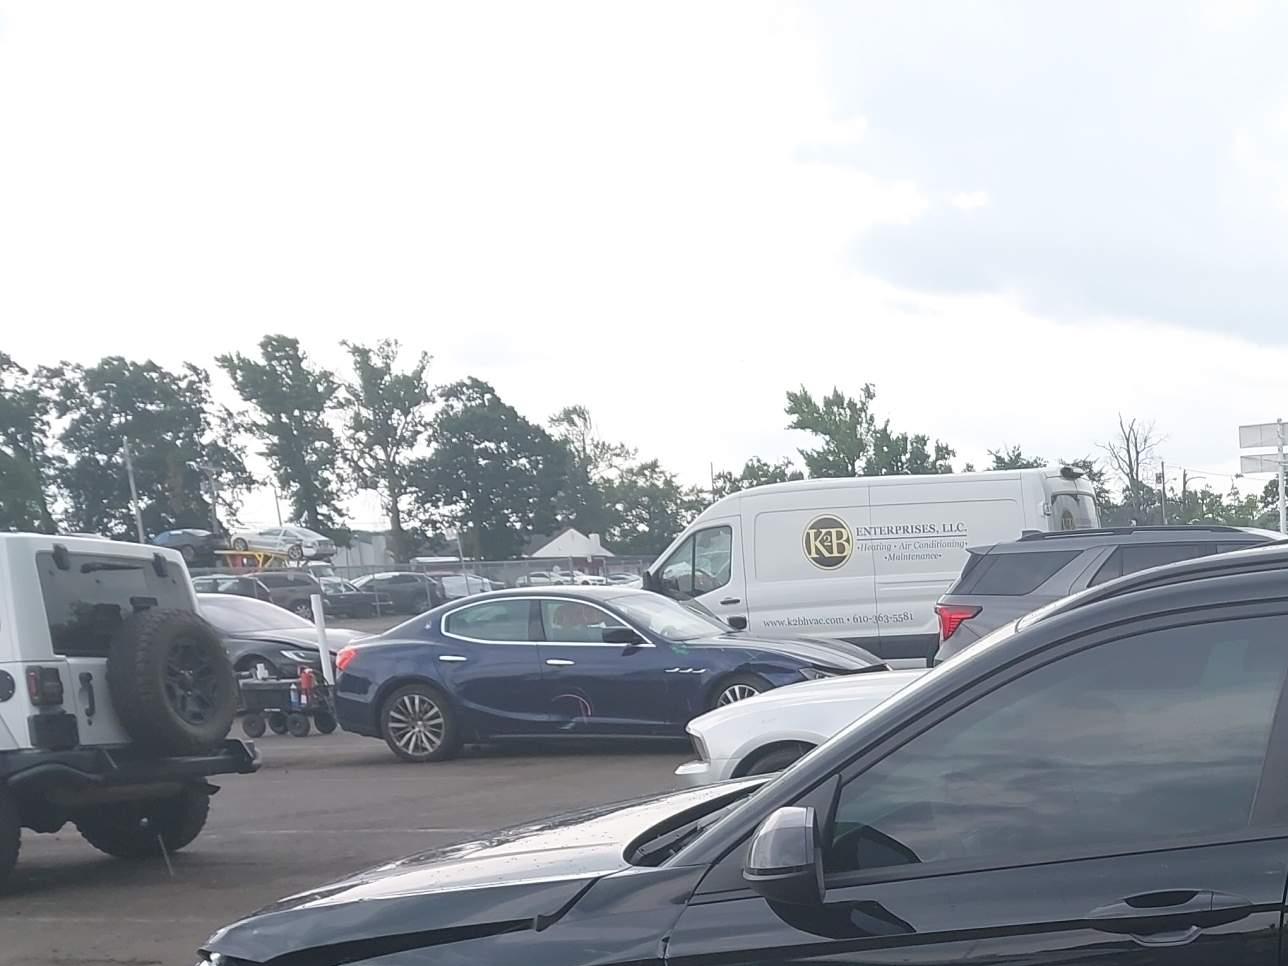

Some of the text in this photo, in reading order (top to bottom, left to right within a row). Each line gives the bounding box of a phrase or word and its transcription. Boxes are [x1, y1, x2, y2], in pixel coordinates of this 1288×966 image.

[856, 522, 967, 536] ENTERPRISES, LLC.
[899, 541, 912, 550] Air
[763, 612, 914, 627] www.k2bhvac.com 610-363-5581
